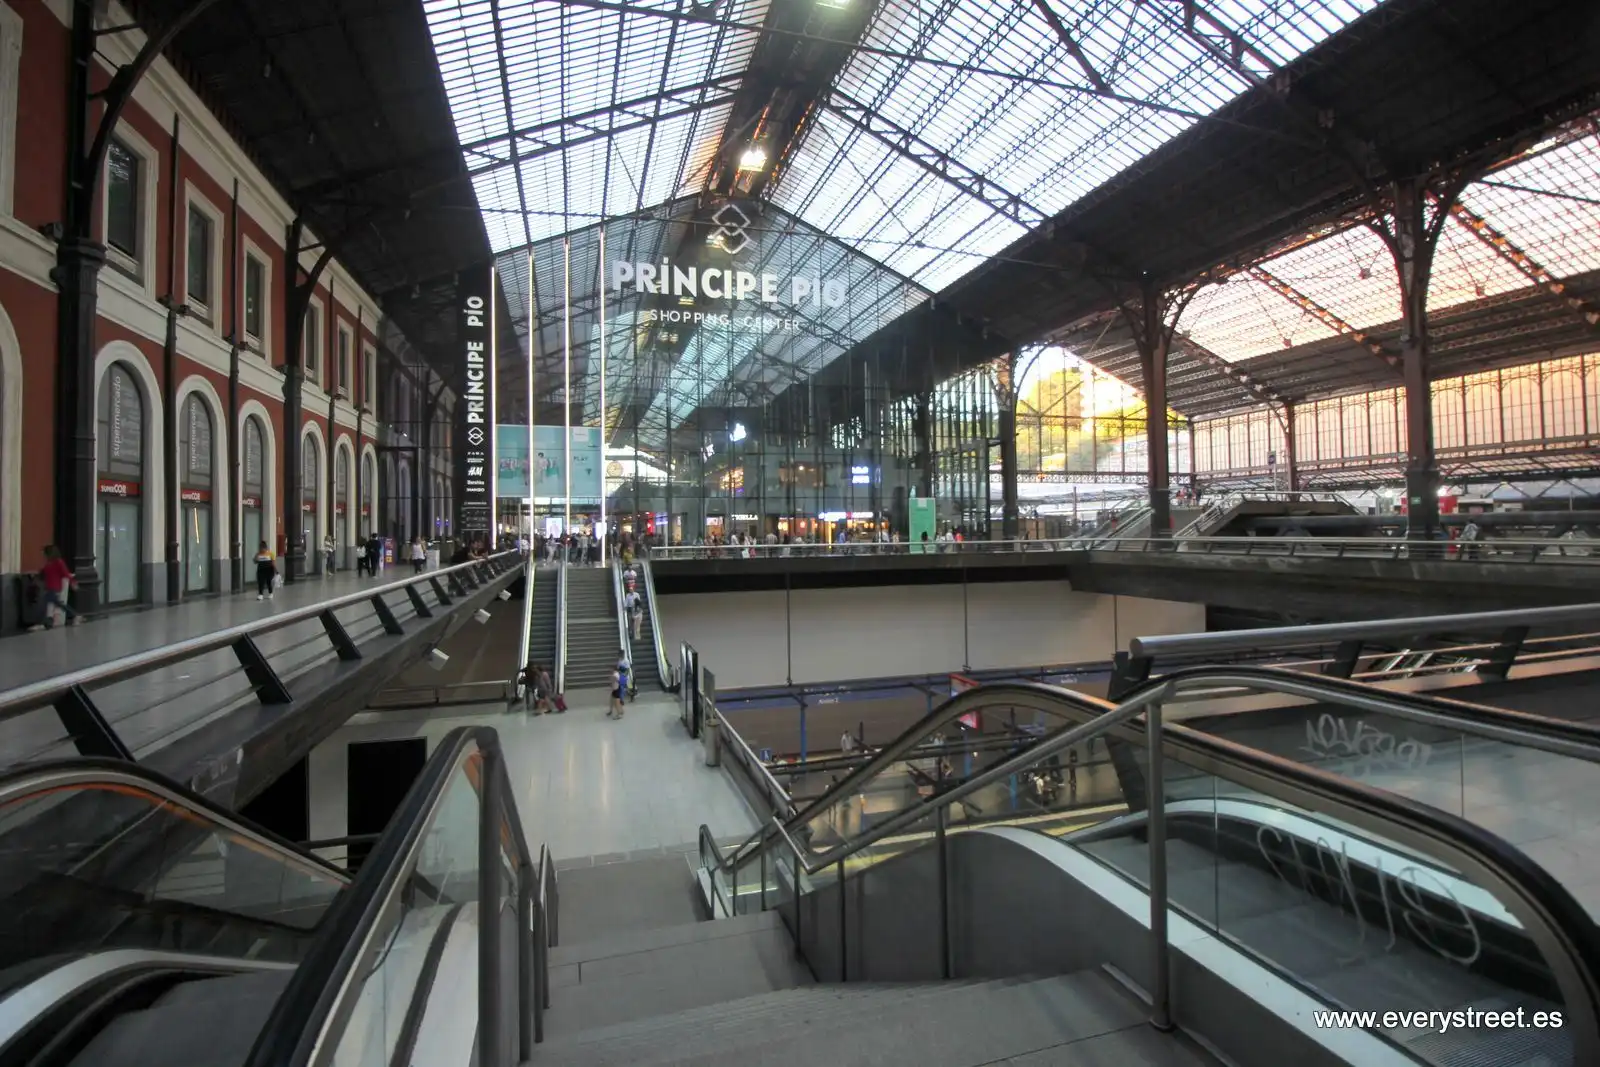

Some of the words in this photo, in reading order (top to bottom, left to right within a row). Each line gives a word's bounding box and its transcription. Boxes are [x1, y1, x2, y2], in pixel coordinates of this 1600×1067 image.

[463, 295, 484, 327] PÍO
[650, 308, 730, 326] SHOPPING
[743, 315, 801, 331] CENTER
[463, 341, 484, 424] PRÍNCIPE
[113, 375, 122, 457] supermercado
